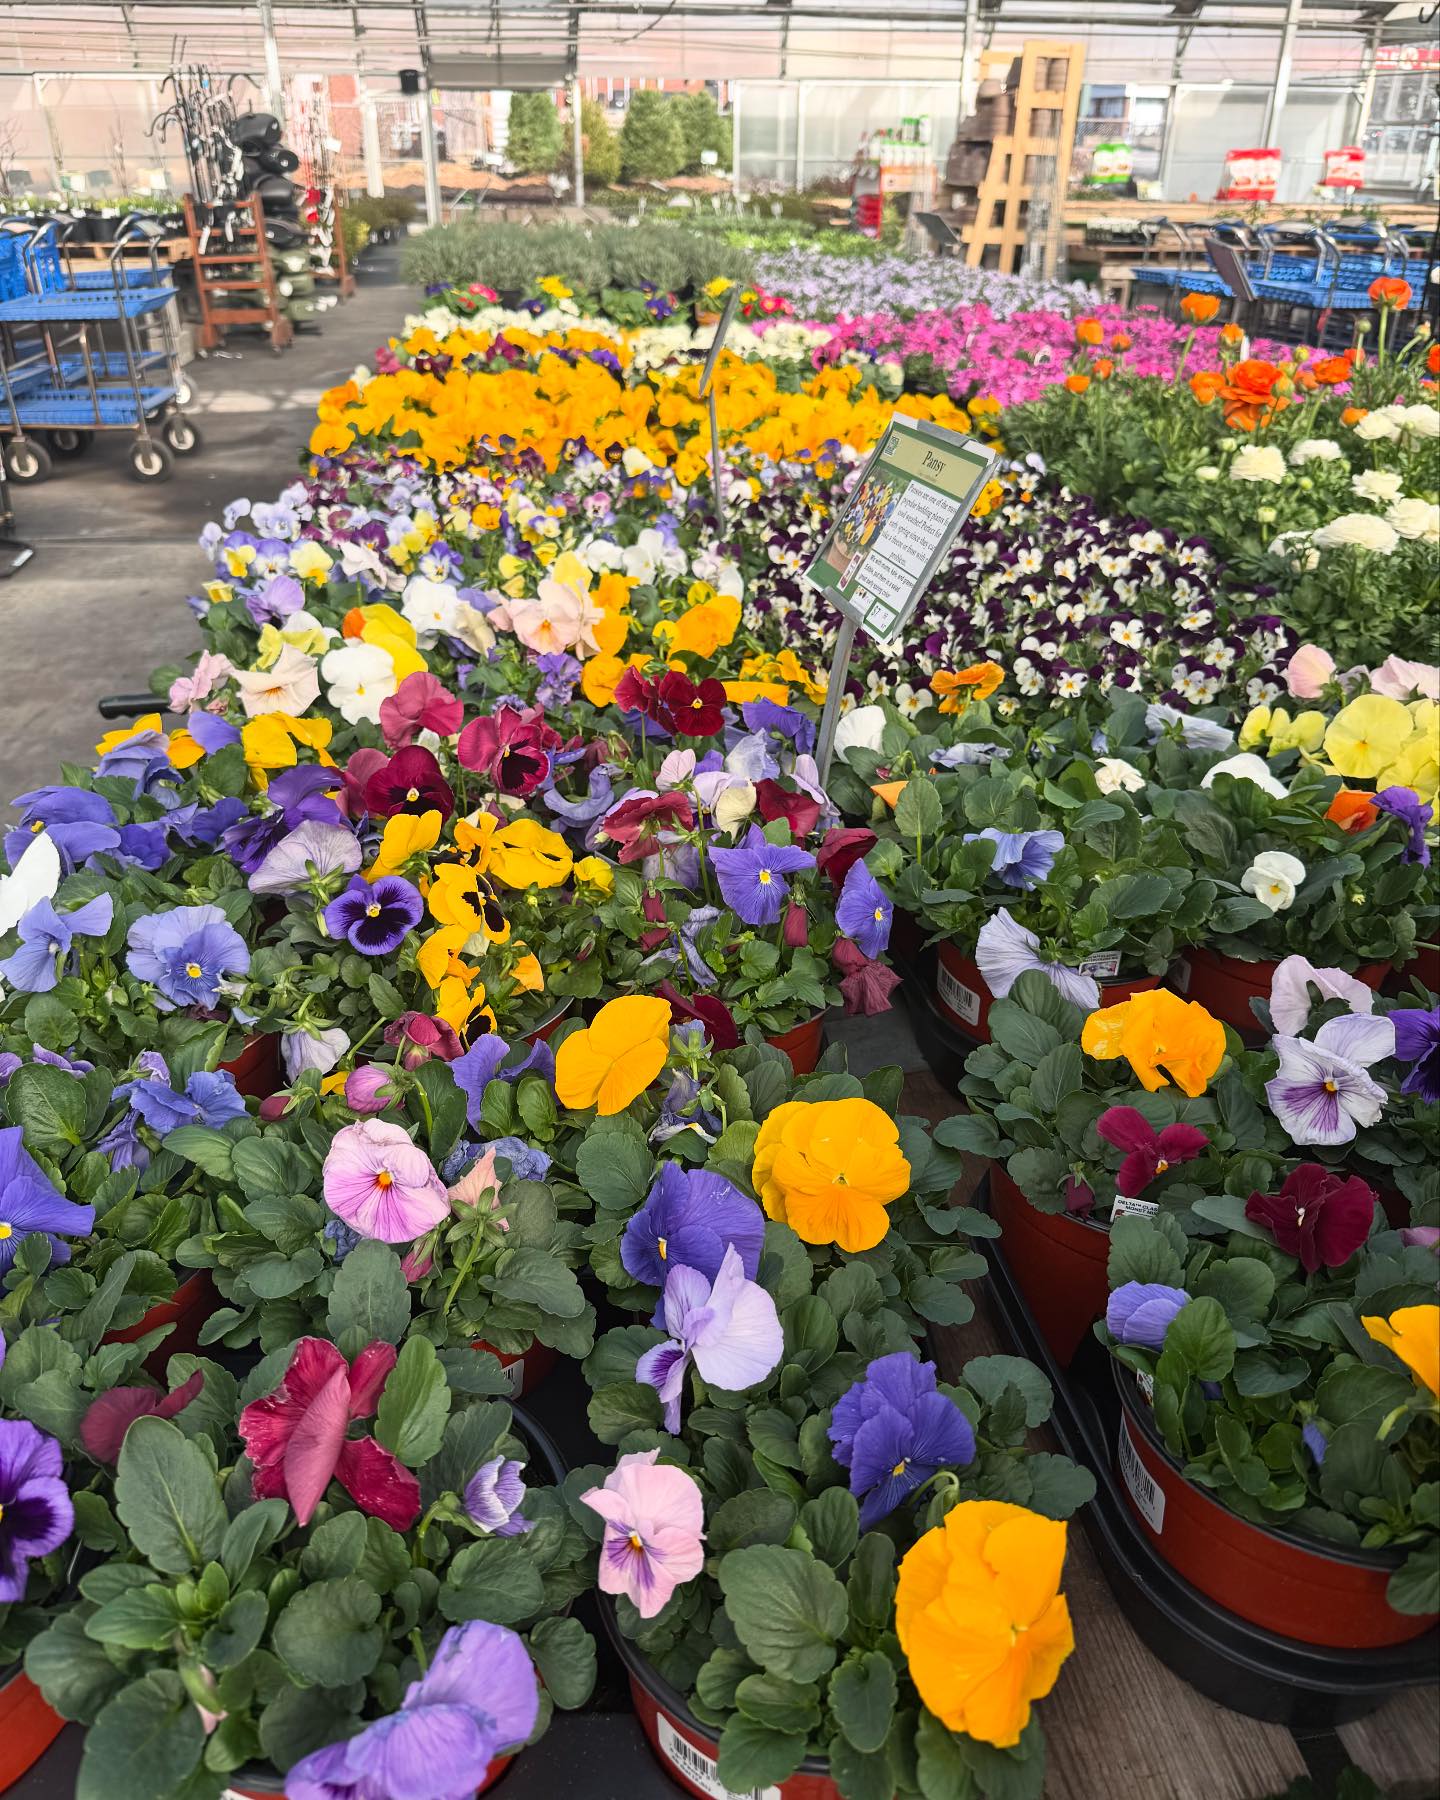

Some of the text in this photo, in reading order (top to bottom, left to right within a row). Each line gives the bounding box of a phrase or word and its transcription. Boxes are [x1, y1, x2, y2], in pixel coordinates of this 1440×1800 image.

[922, 450, 946, 476] Pansy
[908, 484, 923, 496] Pansies
[900, 497, 917, 508] popular
[915, 502, 932, 518] bedding
[929, 511, 944, 524] plants
[897, 525, 910, 538] spring
[908, 531, 920, 542] since
[920, 520, 935, 535] Perfect
[933, 528, 942, 538] for
[890, 535, 903, 548] freeze
[906, 544, 917, 555] frost
